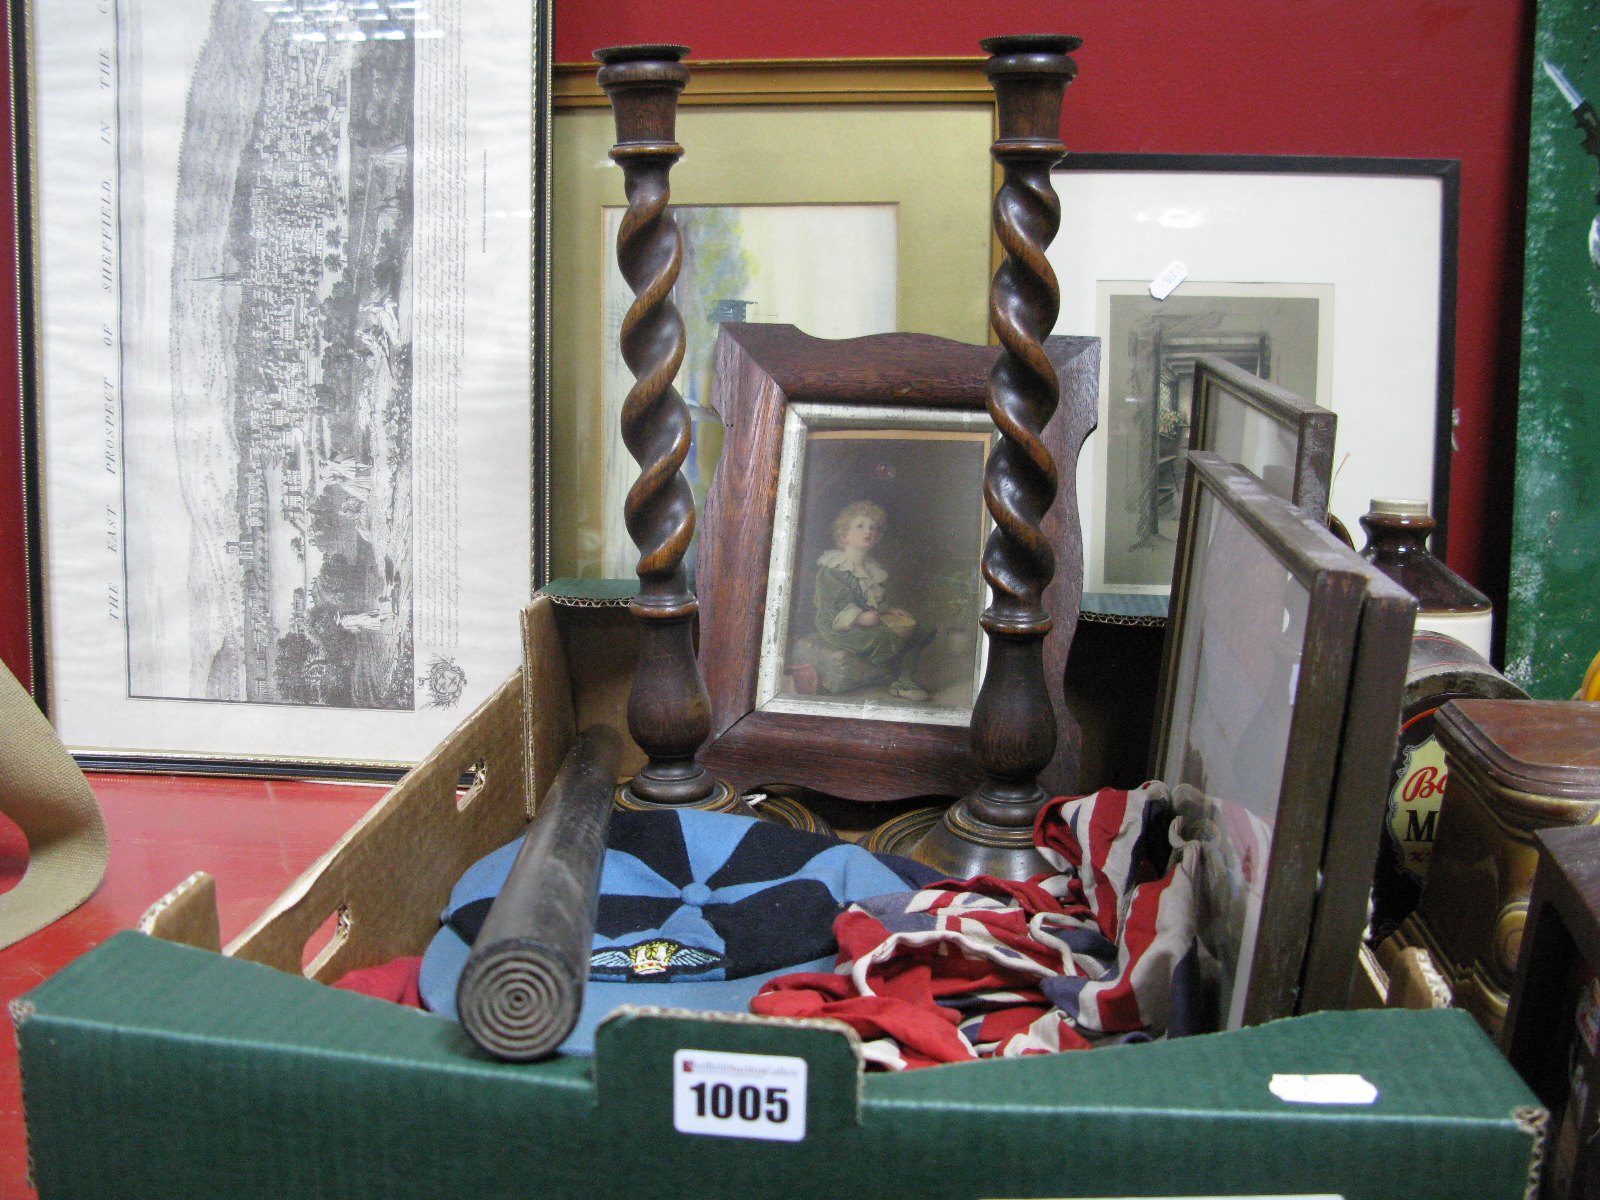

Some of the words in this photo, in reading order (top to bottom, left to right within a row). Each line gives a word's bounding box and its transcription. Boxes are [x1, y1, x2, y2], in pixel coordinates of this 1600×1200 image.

[99, 48, 111, 90] THE
[100, 120, 111, 146] IN
[103, 323, 113, 347] OF
[103, 376, 117, 475] PROSPECT
[107, 505, 118, 554] EAST
[690, 1082, 789, 1124] 1005
